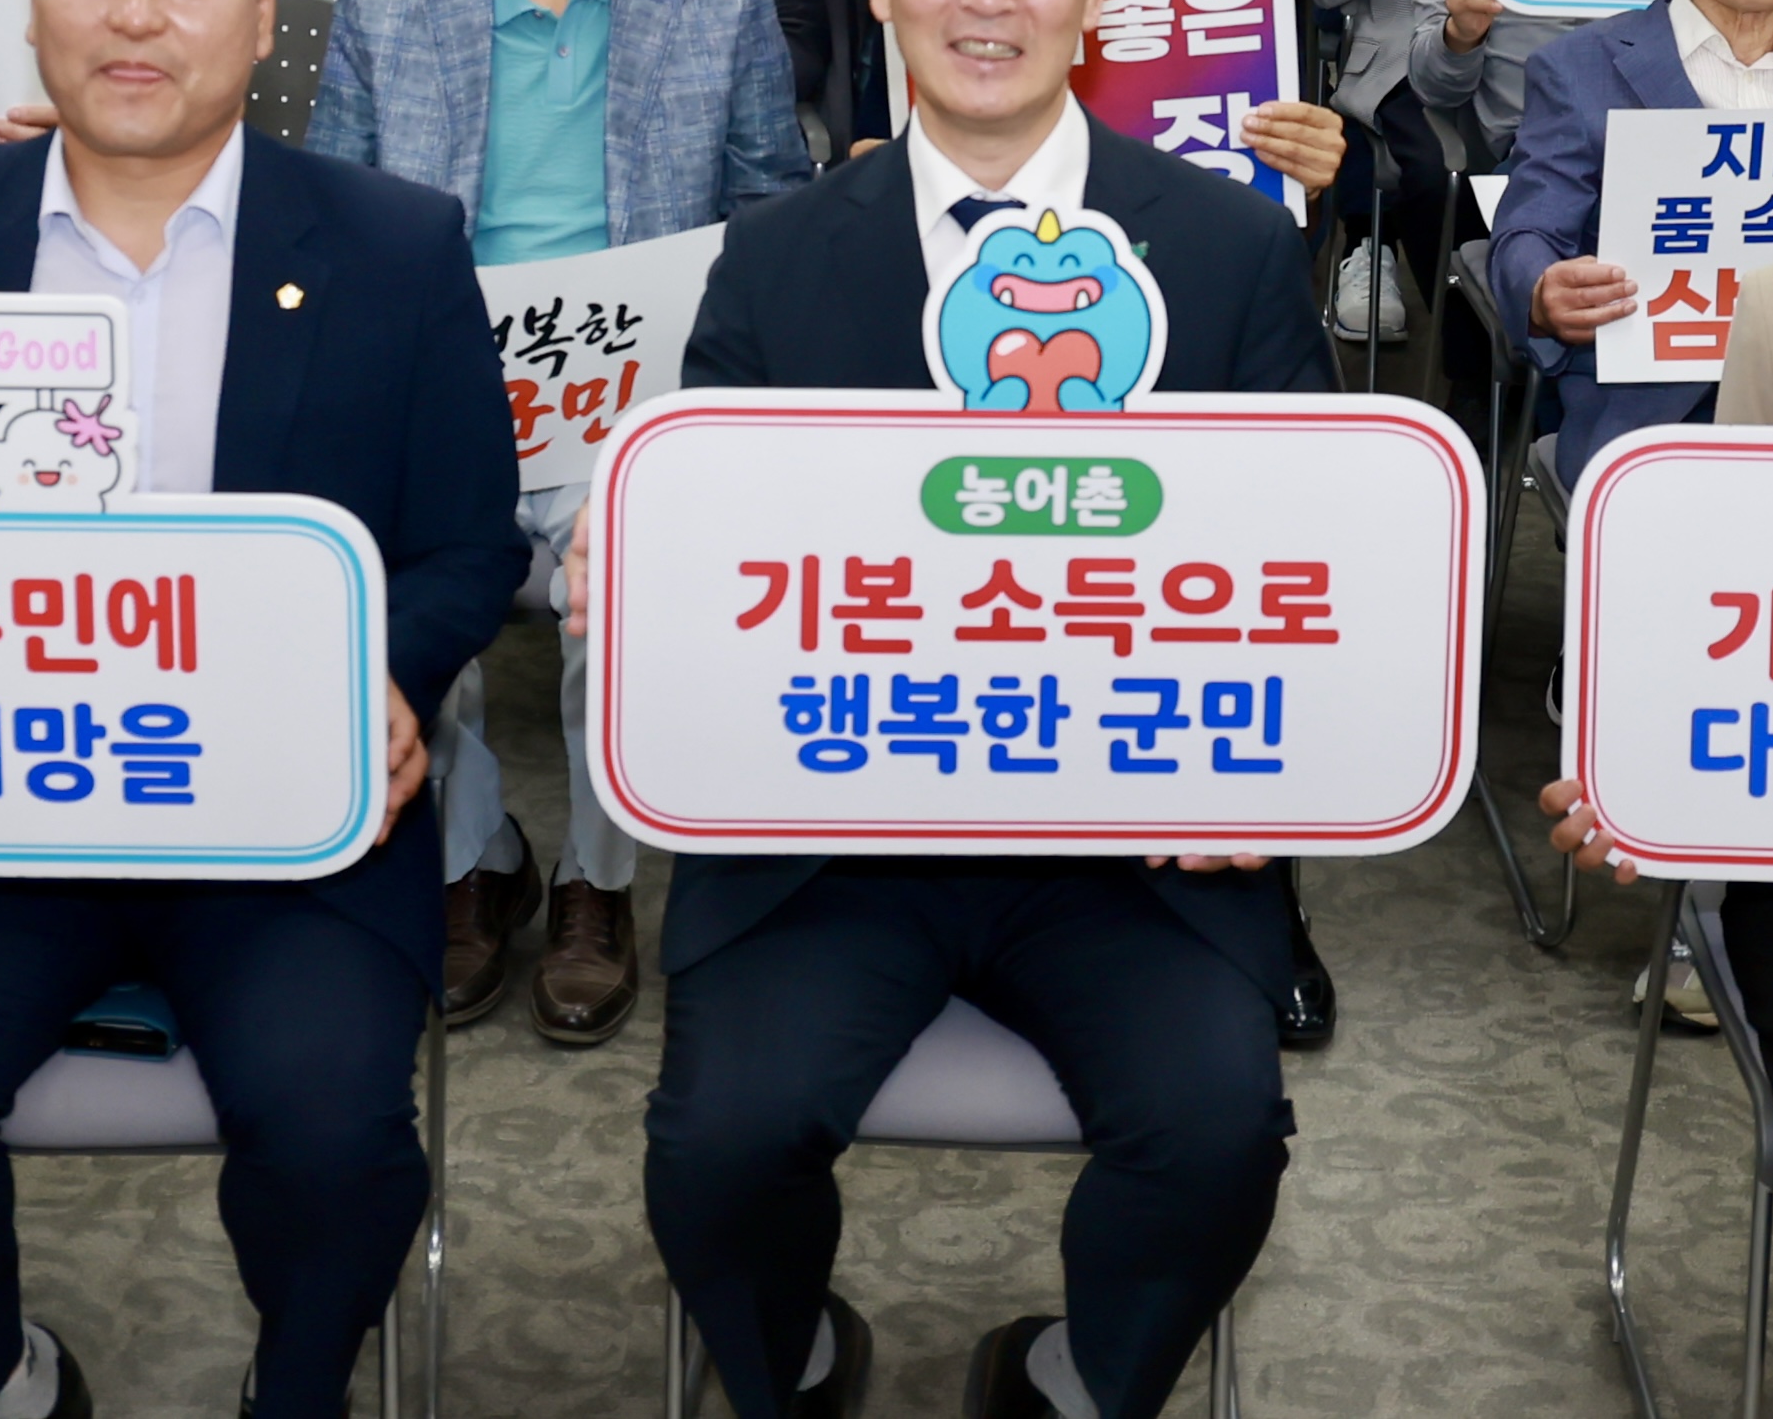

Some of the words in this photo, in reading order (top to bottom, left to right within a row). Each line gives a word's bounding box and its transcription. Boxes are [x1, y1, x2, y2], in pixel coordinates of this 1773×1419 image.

[1651, 196, 1714, 254] 품
[954, 465, 1128, 528] 농어촌
[735, 554, 923, 654] 기본
[954, 557, 1340, 658] 소득으로
[779, 673, 1071, 775] 행복한
[1099, 675, 1284, 774] 군민
